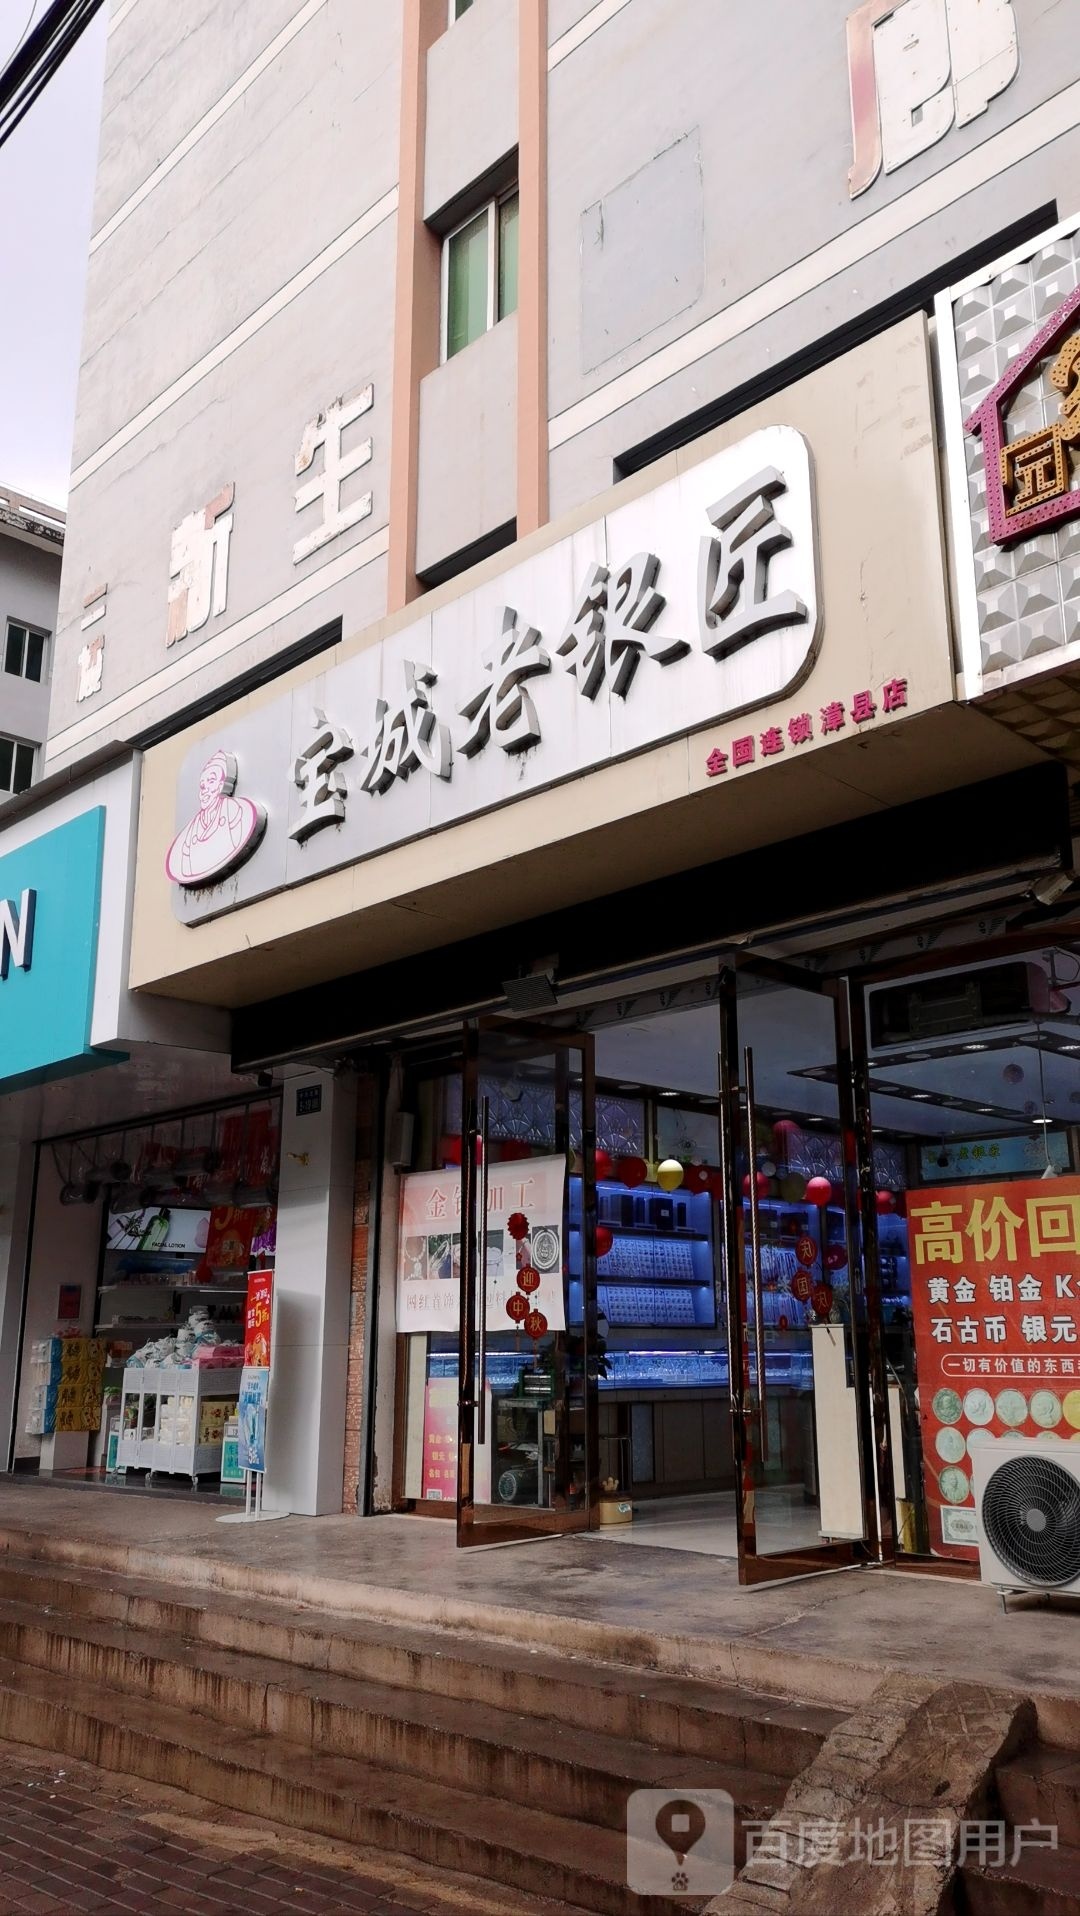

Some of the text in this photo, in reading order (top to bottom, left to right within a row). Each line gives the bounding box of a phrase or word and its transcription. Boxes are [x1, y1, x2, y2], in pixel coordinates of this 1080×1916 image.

[288, 465, 808, 842] 宝城老银匠
[705, 678, 907, 777] 全国连锁漳县店
[910, 1196, 1080, 1264] 高价回
[928, 1274, 1080, 1303] 黄金 铂金 K
[930, 1315, 1077, 1343] 石古币 银元
